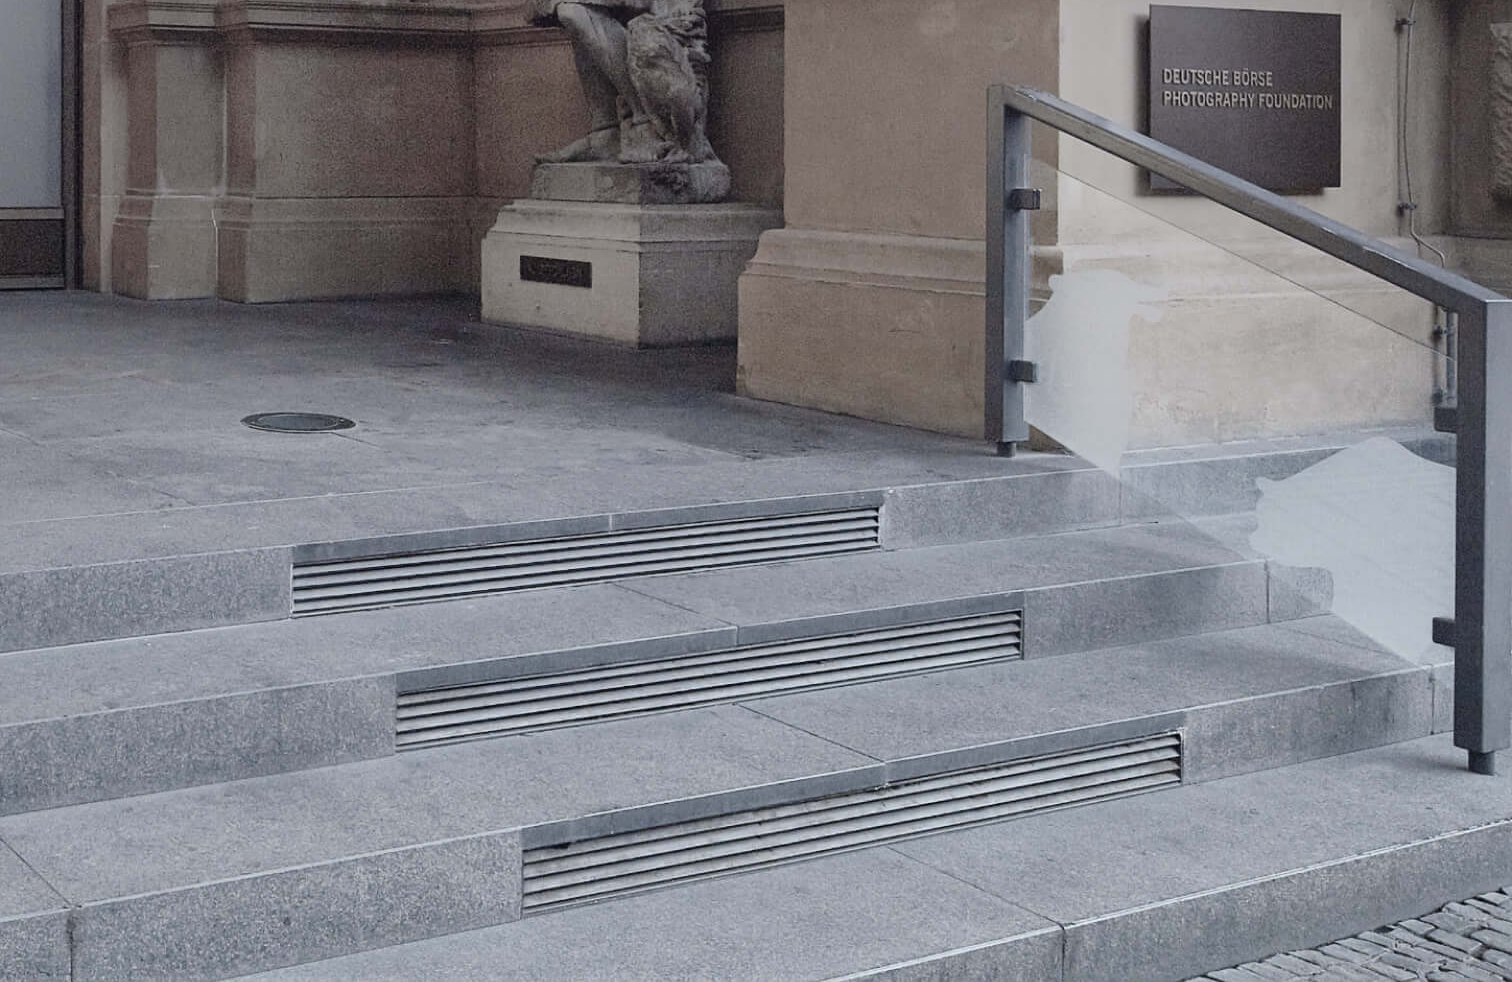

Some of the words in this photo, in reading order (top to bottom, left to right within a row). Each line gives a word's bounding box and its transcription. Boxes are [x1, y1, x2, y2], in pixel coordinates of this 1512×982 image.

[1163, 68, 1229, 85] DEUTSCHE
[1233, 68, 1273, 86] BÖRSE
[1163, 91, 1255, 107] PHOTOGRAPHY
[1258, 93, 1333, 109] FOUNDATION
